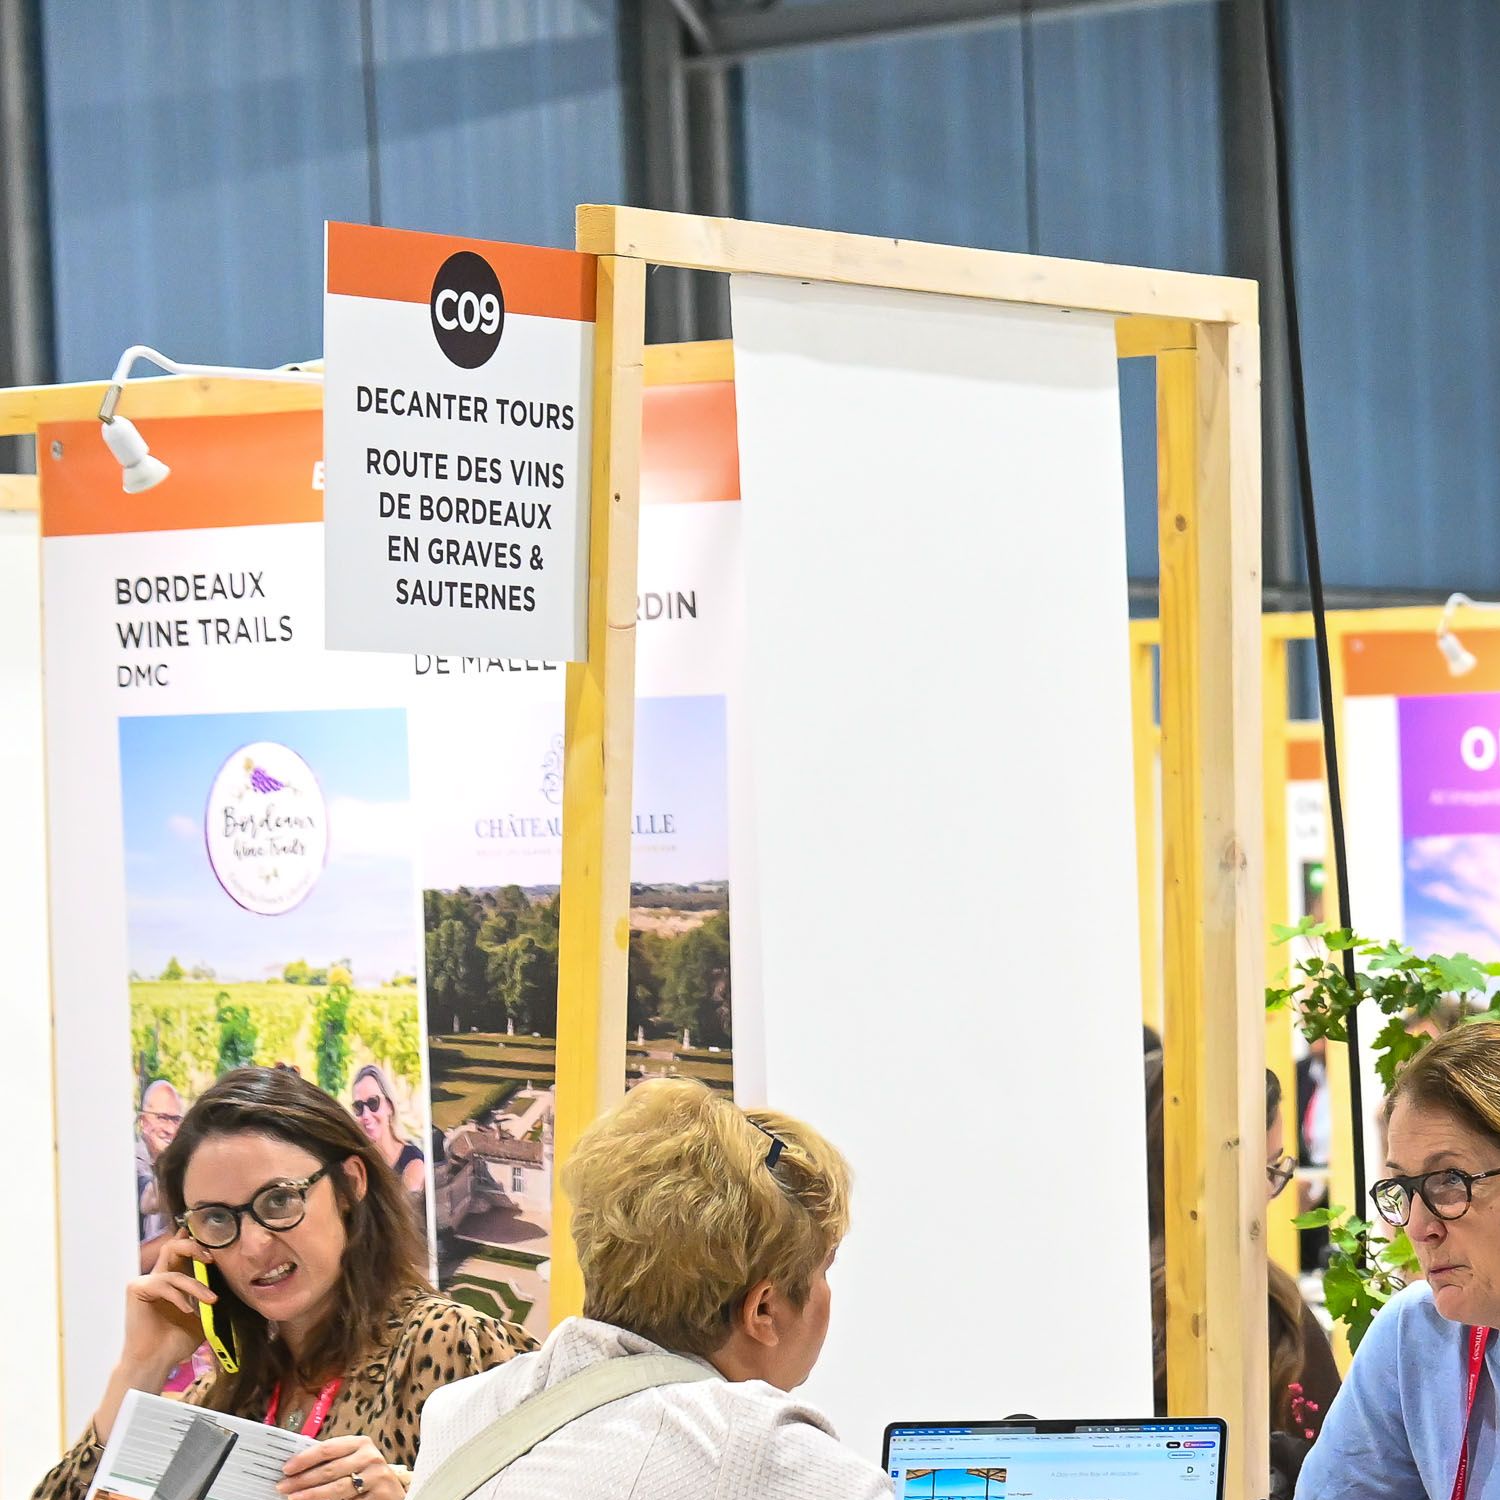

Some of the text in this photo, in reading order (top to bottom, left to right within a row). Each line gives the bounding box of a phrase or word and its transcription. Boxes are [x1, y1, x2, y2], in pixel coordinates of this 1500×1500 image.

[435, 288, 500, 335] C09
[356, 385, 574, 431] DECANTER TOURS
[366, 447, 564, 489] ROUTE DES VINS
[379, 491, 552, 530] DE BORDEAUX
[388, 535, 544, 571] EN GRAVES &
[116, 571, 265, 605] BORDEAUX
[395, 578, 536, 612] SAUTERNES
[117, 615, 293, 649] WINE TRAILS
[117, 664, 169, 688] DMC
